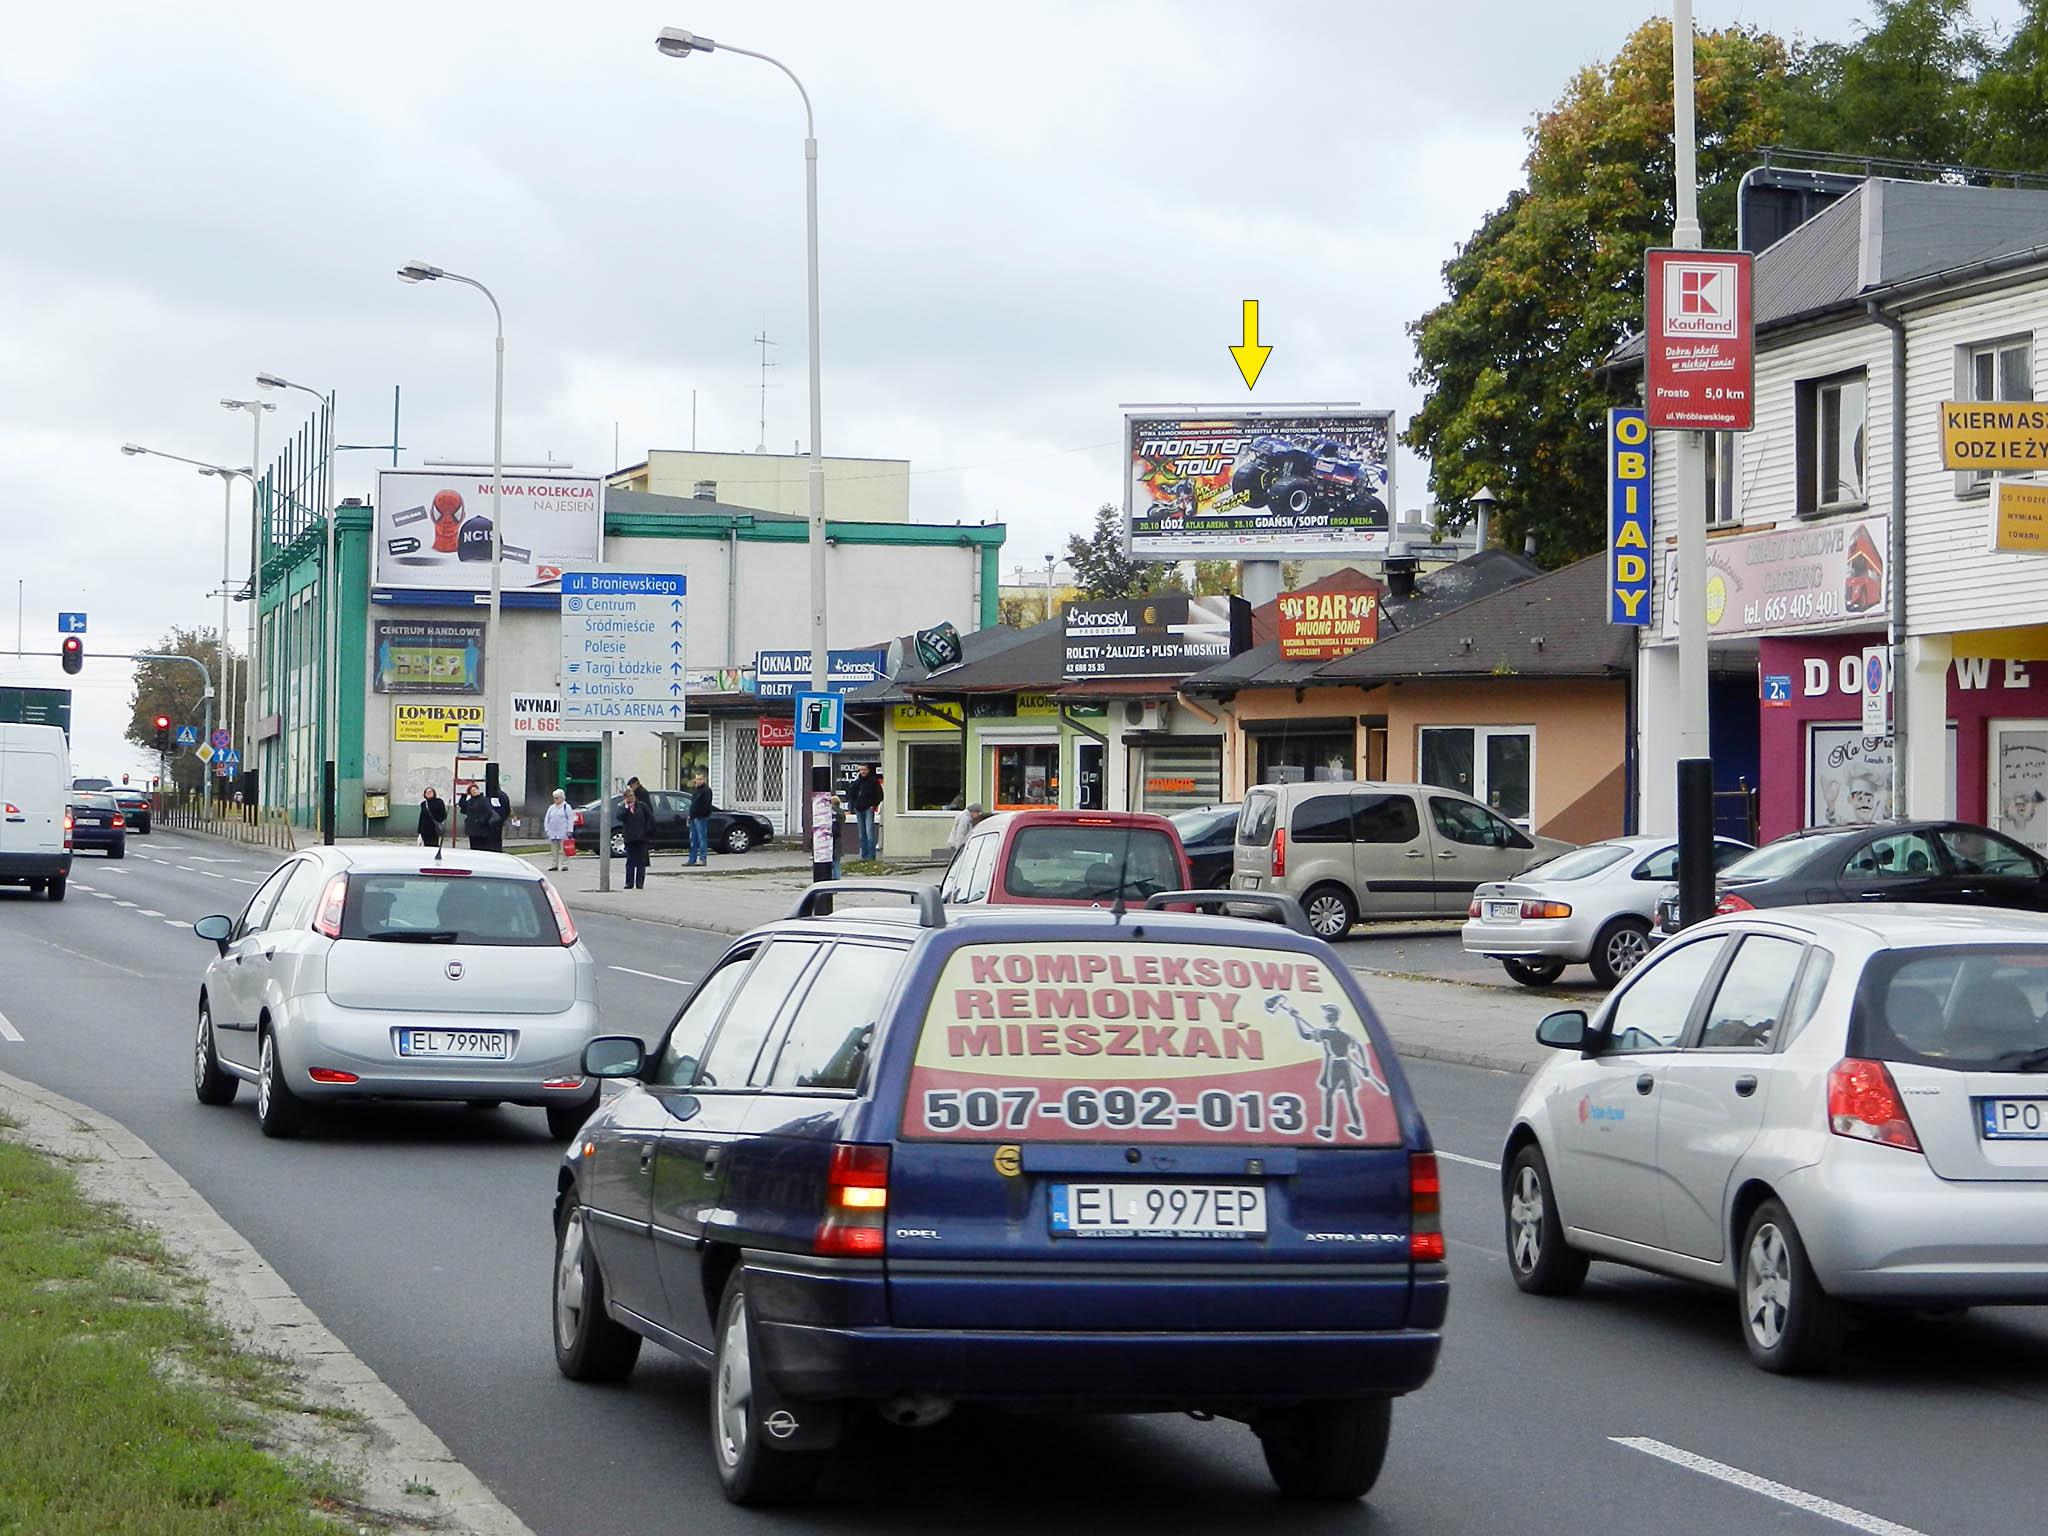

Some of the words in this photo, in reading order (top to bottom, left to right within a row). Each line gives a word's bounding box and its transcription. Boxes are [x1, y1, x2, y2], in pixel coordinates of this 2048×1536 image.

[1669, 318, 1732, 331] Kaufland
[1665, 346, 1692, 357] Dobra
[1657, 388, 1690, 398] Prosto
[1705, 388, 1723, 400] 5,0
[1726, 389, 1744, 399] km
[1949, 412, 2048, 429] KIERMAS
[528, 486, 594, 498] KOLEKCJA
[534, 500, 553, 511] NA
[554, 499, 594, 512] JESIEŃ
[1140, 522, 1159, 530] 20.10
[1160, 517, 1184, 530] ŁÓDŹ
[1185, 521, 1205, 529] ATLAS
[1255, 514, 1329, 528] GDAŃSK/SOPOT
[1330, 518, 1348, 526] ERGO
[1349, 517, 1373, 525] ARENA
[1616, 417, 1648, 617] OBIADY
[2008, 513, 2043, 521] WYMIANA
[2008, 531, 2040, 540] TOWARU
[573, 578, 587, 589] ul.
[592, 577, 677, 594] Broniewskiego
[586, 598, 636, 611] Centrum
[1305, 595, 1347, 620] BAR
[1744, 603, 1761, 625] tel.
[1764, 598, 1787, 622] 665
[1789, 593, 1813, 619] 405
[1816, 590, 1839, 615] 401
[585, 616, 655, 632] Śródmieście
[1077, 610, 1128, 627] oknostyl
[380, 626, 424, 636] CENTRUM
[427, 626, 481, 637] HANDLOWE
[1295, 621, 1332, 636] PHUONG
[1334, 620, 1361, 635] DONG
[585, 640, 626, 652] Polesie
[922, 631, 955, 662] LECH
[1066, 646, 1100, 659] ROLETY
[1106, 644, 1145, 659] ŻALUZJE
[1152, 645, 1178, 657] PLISY
[586, 661, 615, 677] Targi
[619, 661, 662, 674] Łódzkie
[762, 656, 792, 672] OKNA
[585, 682, 634, 695] Lotnisko
[760, 684, 793, 695] ROLETY
[514, 698, 560, 713] WYNAJ
[584, 703, 620, 716] ATLAS
[624, 703, 664, 716] ARENA
[398, 707, 481, 720] LOMBARD
[514, 717, 534, 731] tel.
[971, 954, 1323, 994] KOMPLEKSOWE
[954, 988, 1242, 1024] REMONTY
[413, 1033, 438, 1050] EL
[446, 1033, 502, 1052] 799NR
[947, 1021, 1264, 1061] MIESZKAŃ
[926, 1085, 1306, 1134] 507-692-013
[2002, 1103, 2040, 1130] PO
[1076, 1188, 1128, 1225] EL
[1146, 1188, 1258, 1226] 997EP
[896, 1229, 942, 1240] OPEL
[1305, 1233, 1355, 1242] ASTRA
